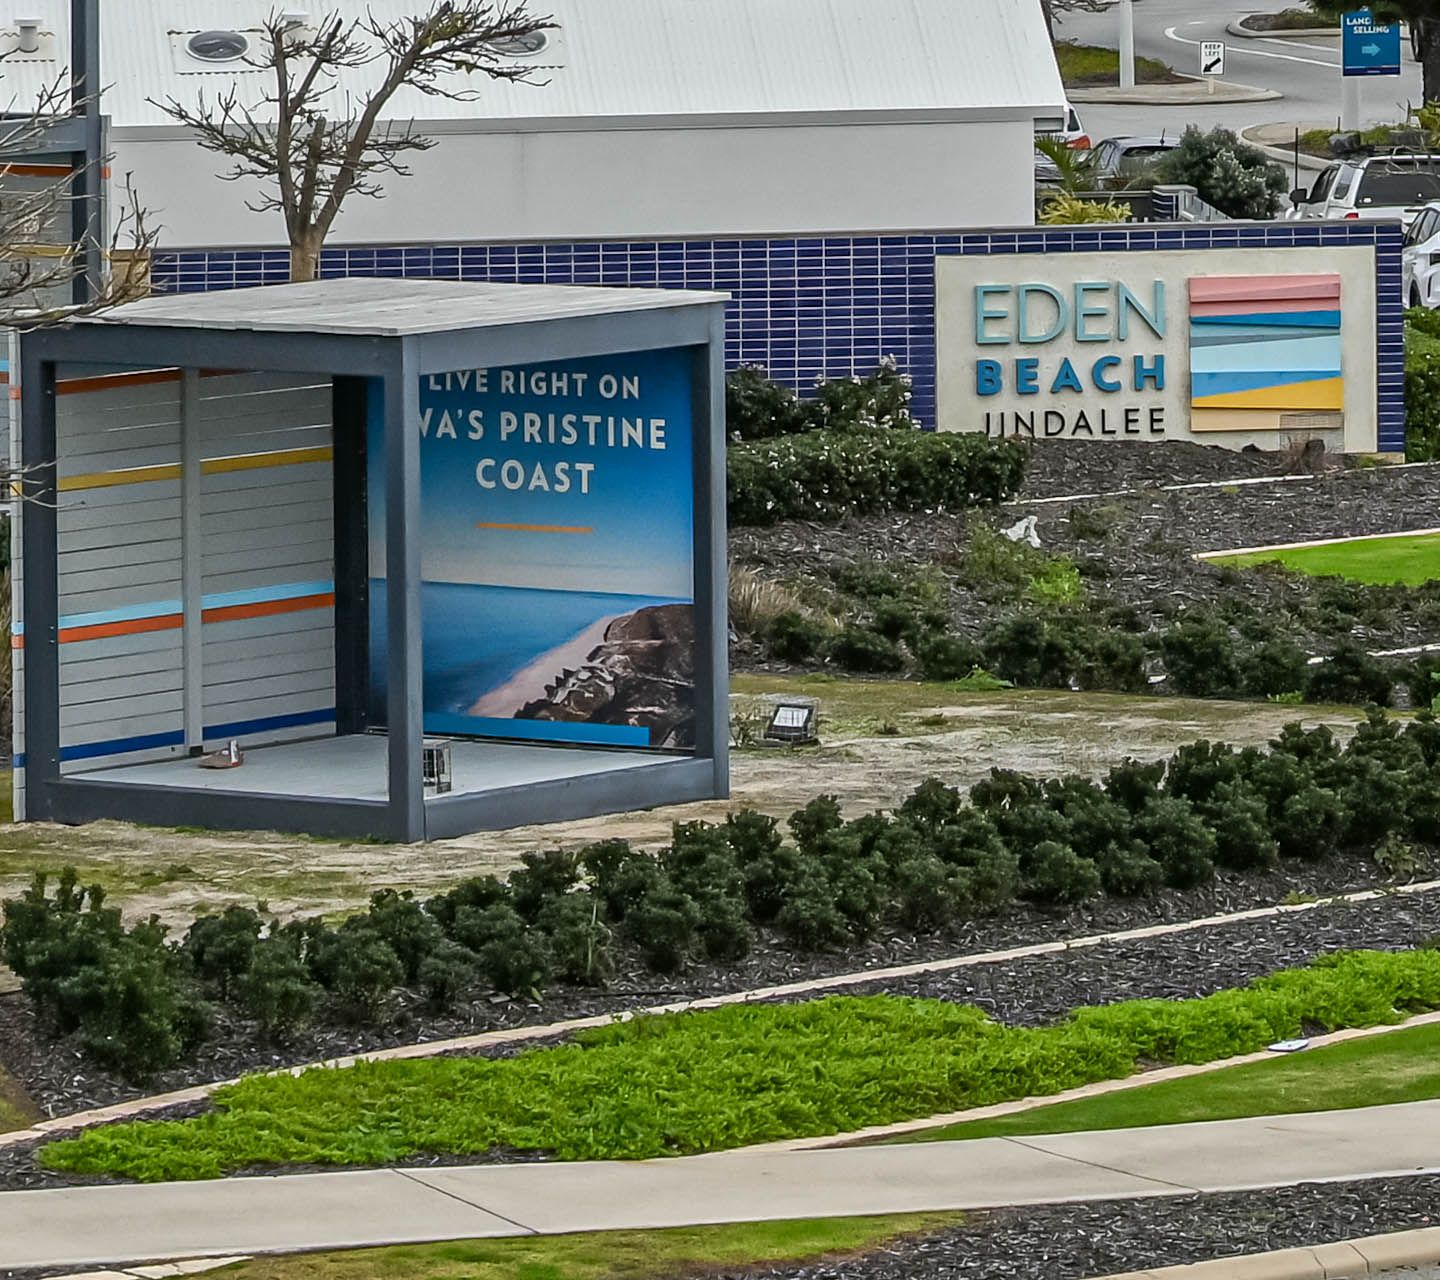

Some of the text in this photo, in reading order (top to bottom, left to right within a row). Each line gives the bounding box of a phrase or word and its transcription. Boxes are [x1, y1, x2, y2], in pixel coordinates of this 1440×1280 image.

[974, 278, 1166, 346] EDEN
[427, 368, 641, 400] LIVE RIGHT ON
[975, 354, 1166, 397] BEACH
[499, 410, 667, 450] PRISTINE
[983, 407, 1167, 438] JINDALEE
[475, 457, 596, 495] COAST
